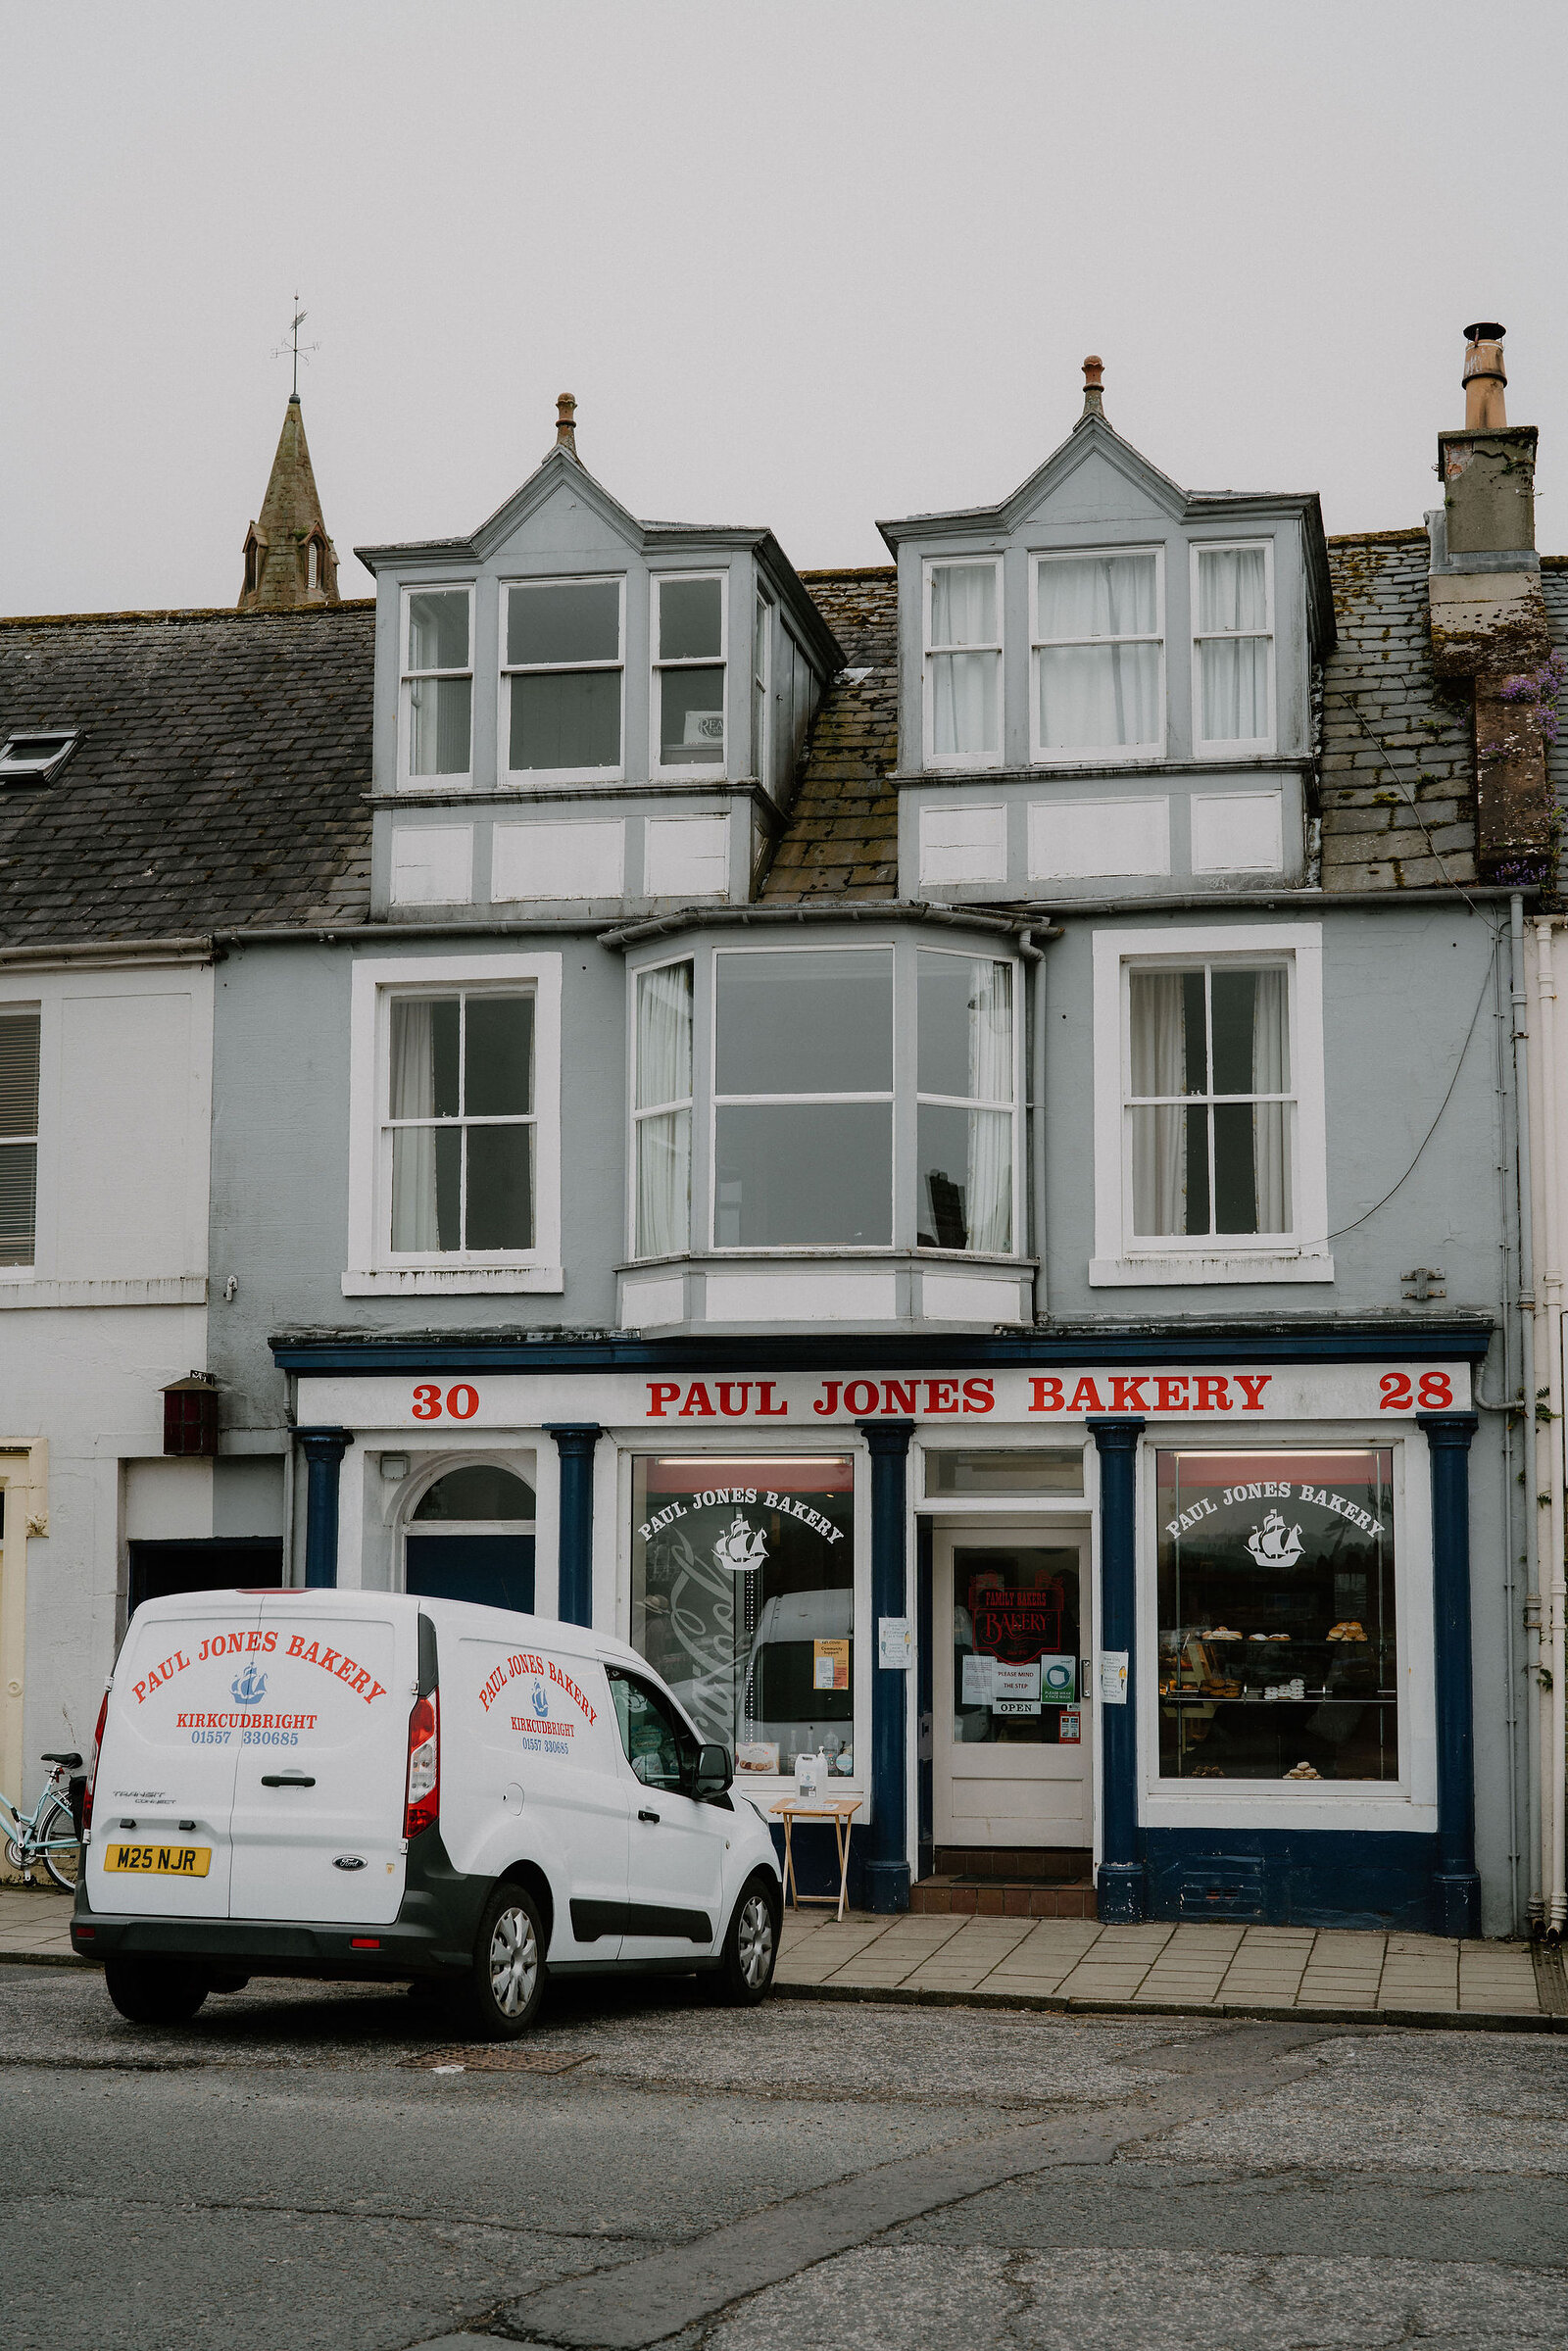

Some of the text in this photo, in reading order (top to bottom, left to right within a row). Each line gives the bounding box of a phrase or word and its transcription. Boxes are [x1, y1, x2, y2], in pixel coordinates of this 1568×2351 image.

[412, 1384, 479, 1420] 30
[646, 1375, 1272, 1417] PAUL JONES BAKERY
[1379, 1372, 1453, 1410] 28
[637, 1487, 845, 1544] PAUL JONES BAKERY
[1165, 1481, 1386, 1540] PAUL JONES BAKERY
[986, 1592, 1047, 1606] FAMILY BAKERS
[131, 1631, 387, 1704] PAUL JONES BAKERY
[478, 1653, 598, 1727] PAUL JONES BAKERY
[1001, 1703, 1032, 1712] OPEN
[176, 1713, 318, 1730] KIRKCUDBRIGHT
[511, 1716, 574, 1738] KIRKCUDBRIGHT
[191, 1731, 299, 1746] 01557 330685
[522, 1737, 542, 1751] 01557
[117, 1847, 196, 1872] M25 NJR
[339, 1857, 359, 1867] Ford
